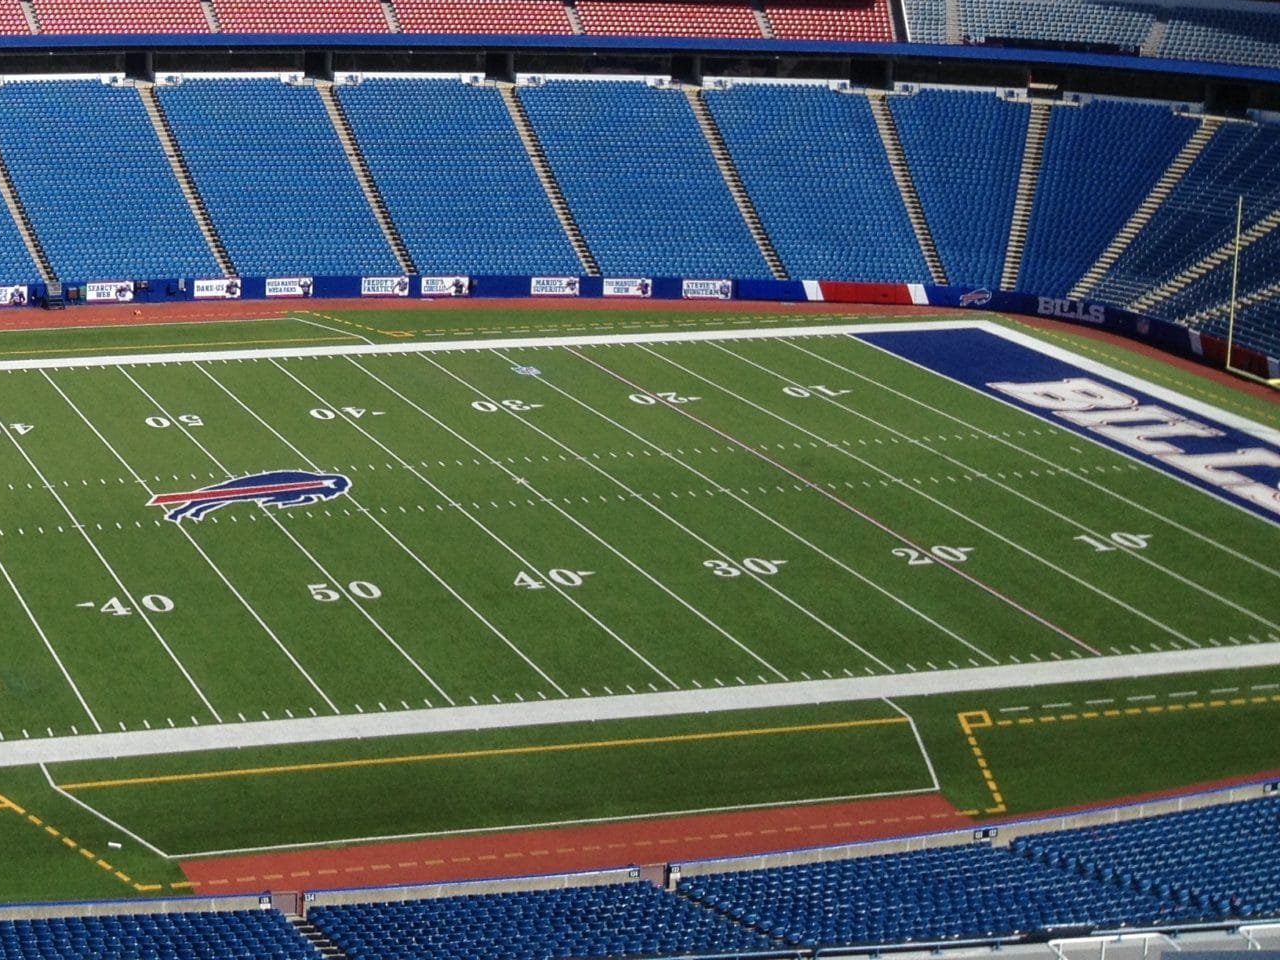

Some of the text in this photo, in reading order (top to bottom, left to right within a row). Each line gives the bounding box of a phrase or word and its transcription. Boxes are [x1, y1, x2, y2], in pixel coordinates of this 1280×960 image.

[1037, 296, 1105, 323] BILLS
[628, 391, 690, 406] 20
[782, 384, 842, 398] 10
[309, 406, 368, 420] 40
[471, 399, 531, 413] 30
[144, 413, 204, 429] 50
[1073, 531, 1148, 552] 10
[891, 544, 969, 566] 20
[702, 557, 778, 578] 30
[513, 568, 584, 590] 40
[306, 580, 382, 602] 50
[100, 593, 175, 616] 40
